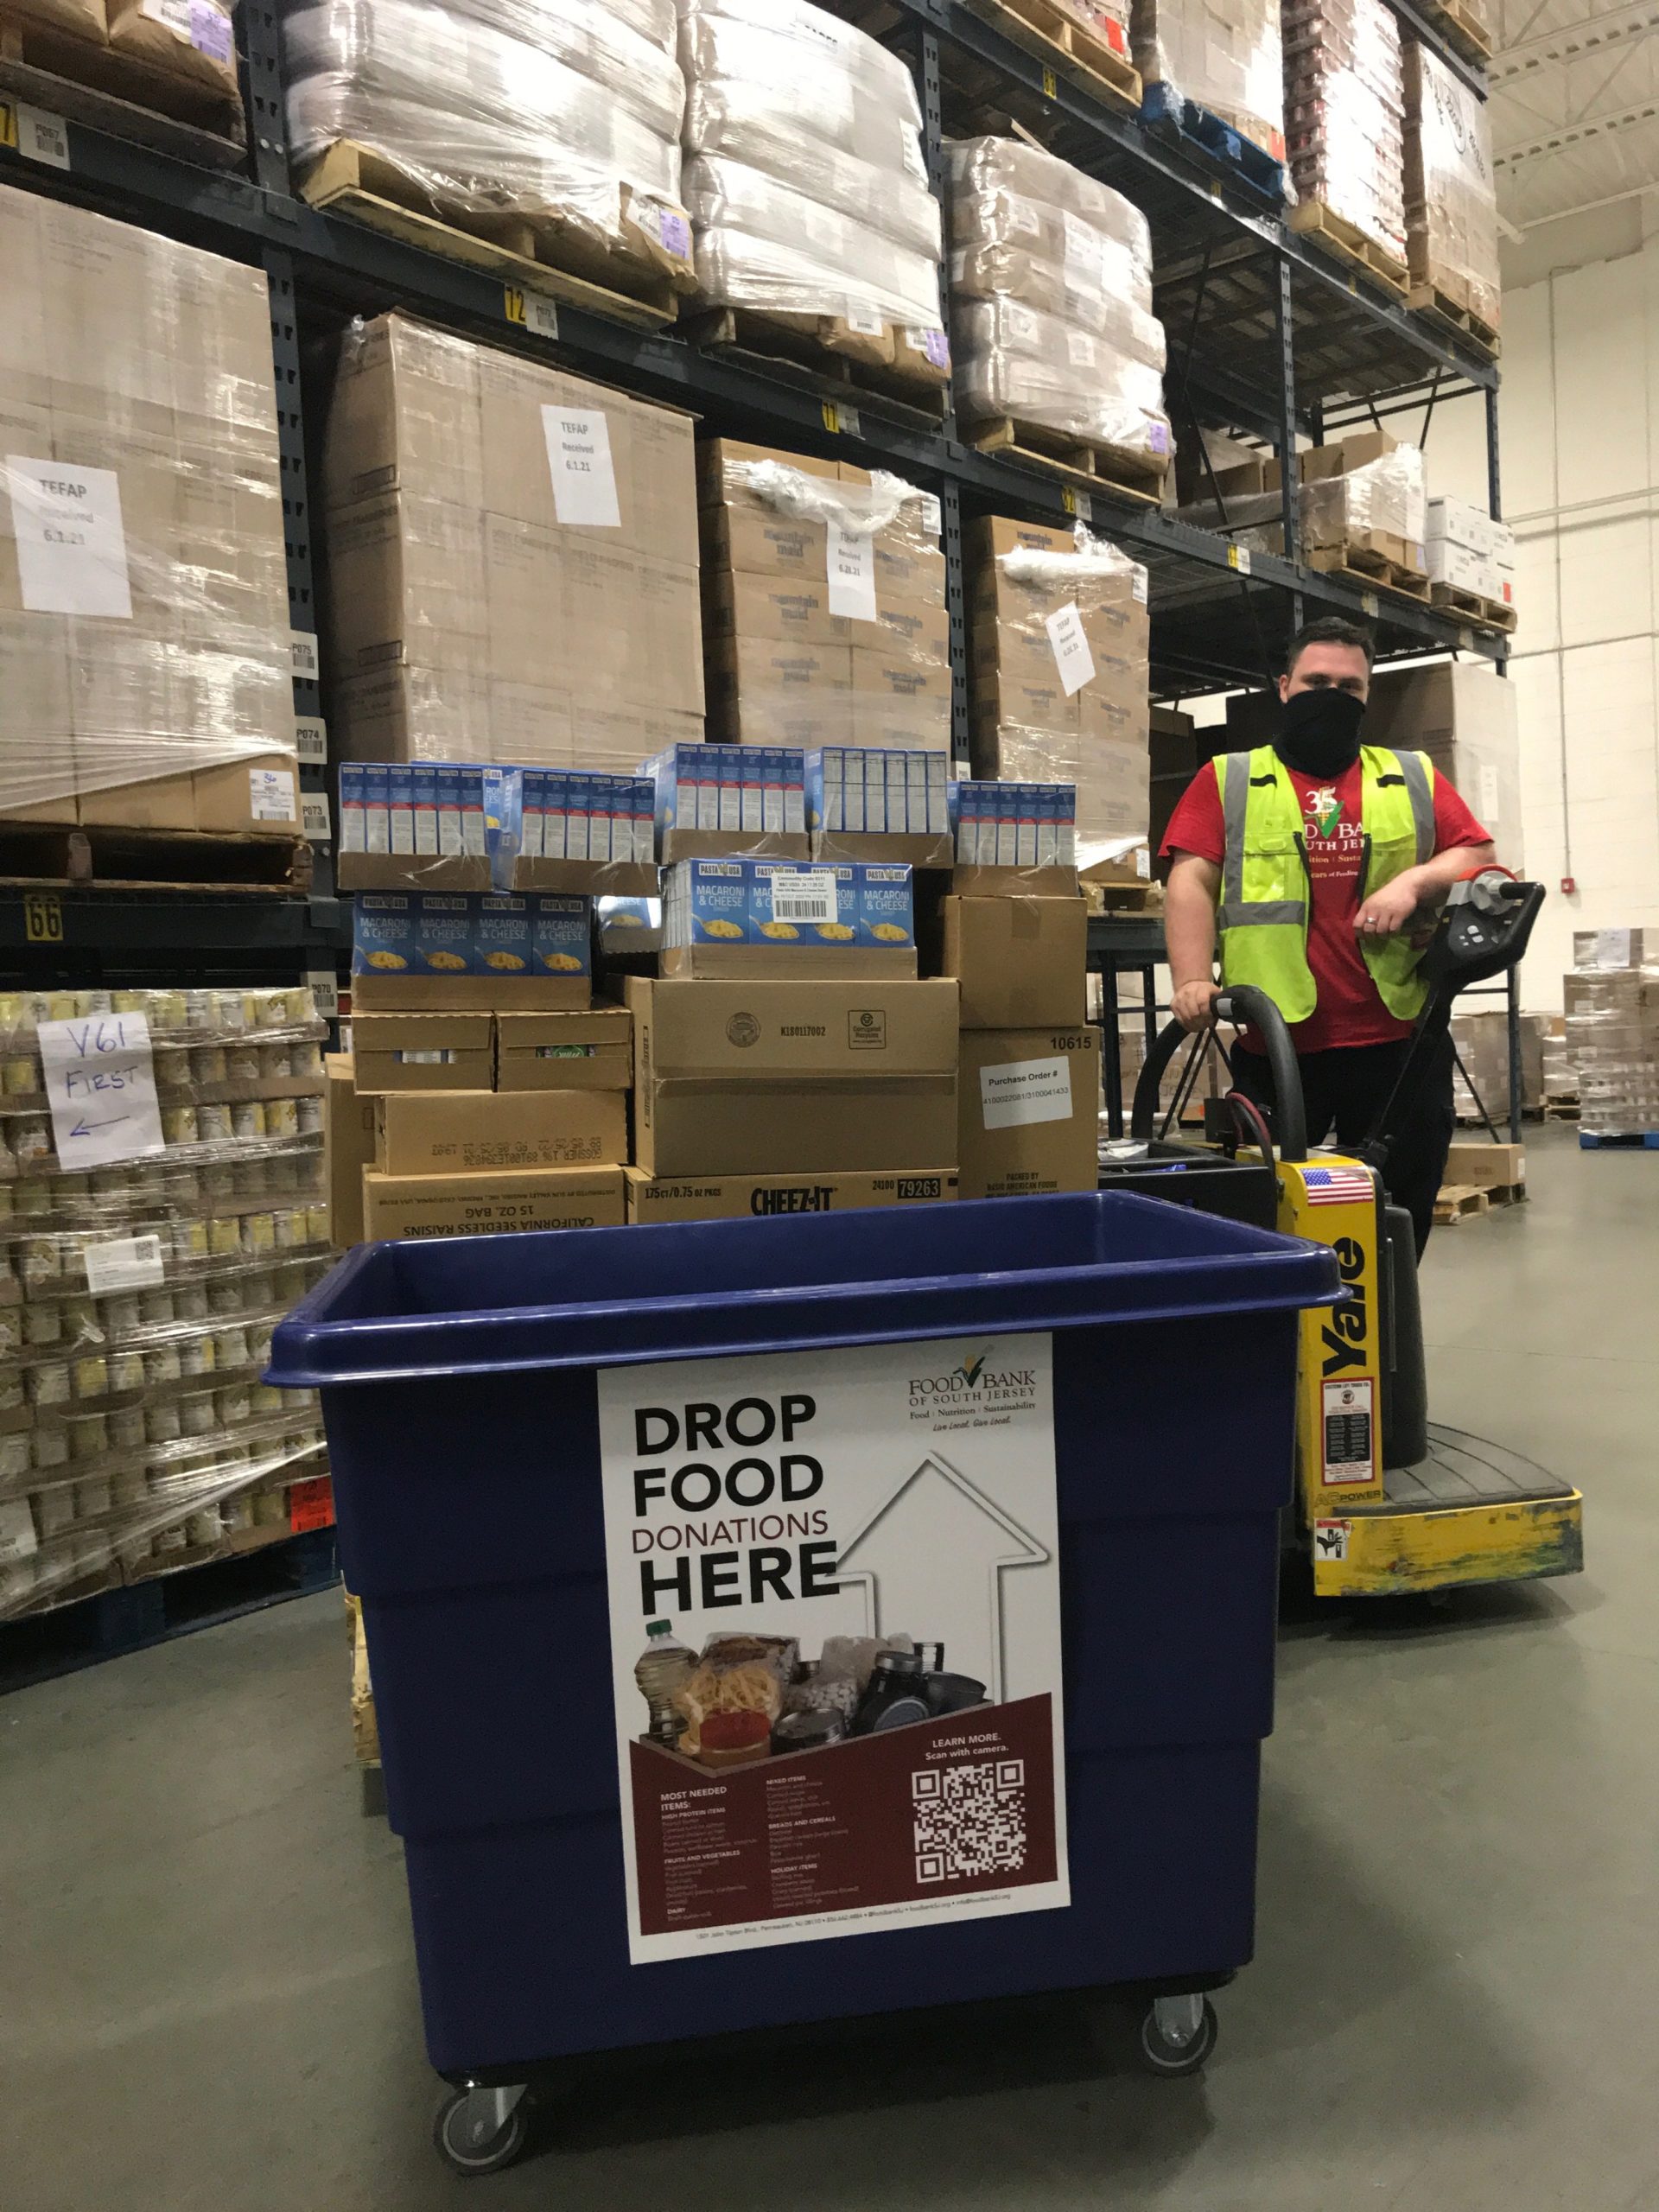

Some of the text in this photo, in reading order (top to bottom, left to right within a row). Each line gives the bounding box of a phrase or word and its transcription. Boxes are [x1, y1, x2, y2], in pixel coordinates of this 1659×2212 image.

[561, 422, 588, 435] TEFAP
[563, 442, 594, 454] Received
[566, 461, 591, 472] 6.1.21
[39, 479, 87, 499] TEFAP
[292, 643, 312, 655] P075
[297, 729, 320, 740] P074
[1305, 786, 1338, 814] 35
[302, 805, 323, 816] P073
[701, 864, 741, 875] PASTA USA
[840, 869, 852, 878] USA
[868, 869, 885, 880] PASTA
[696, 885, 745, 897] MACARONI
[864, 890, 910, 901] MACARONI
[699, 897, 743, 907] & CHEESE
[867, 900, 908, 911] & CHEESE
[30, 896, 60, 938] 66
[359, 917, 410, 928] MACARONI
[420, 918, 470, 929] MACARONI
[479, 918, 529, 929] MACARONI
[537, 920, 586, 931] MACARONI
[372, 928, 408, 938] CHEESE
[431, 929, 467, 939] CHEESE
[491, 929, 526, 939] CHEESE
[549, 930, 583, 940] CHEESE
[1051, 1036, 1091, 1051] 10615
[988, 1074, 1027, 1086] Purchase
[1028, 1071, 1052, 1081] Order
[1031, 1172, 1039, 1180] BY
[872, 1179, 939, 1198] 24100 79263
[1006, 1182, 1037, 1191] AMERICAN
[465, 1205, 533, 1218] 15 OZ. BAG
[404, 1217, 594, 1236] CALIFORNIA SEEDLESS RAISINS
[909, 1370, 1036, 1395] FOOD BANK
[909, 1387, 1036, 1407] OF SOUTH JERSEY
[910, 1402, 1036, 1420] Food Nutrition Sustainability
[634, 1395, 817, 1456] DROP
[973, 1419, 988, 1427] Give
[633, 1454, 823, 1516] FOOD
[1340, 1491, 1382, 1503] POWER
[632, 1510, 829, 1554] DONATIONS
[639, 1540, 840, 1616] HERE
[932, 1732, 1001, 1748] LEARN MORE.
[925, 1745, 1009, 1761] Scan with camera.
[660, 1786, 727, 1802] MOST NEEDED
[661, 1801, 690, 1812] ITEMS:
[684, 1808, 706, 1818] PROTEIN
[707, 1807, 726, 1815] ITEMS
[809, 1815, 836, 1825] CEREALS
[685, 1853, 702, 1862] AND
[702, 1849, 741, 1860] VEGETABLES
[771, 1863, 817, 1874] HOLIDAY ITEMS
